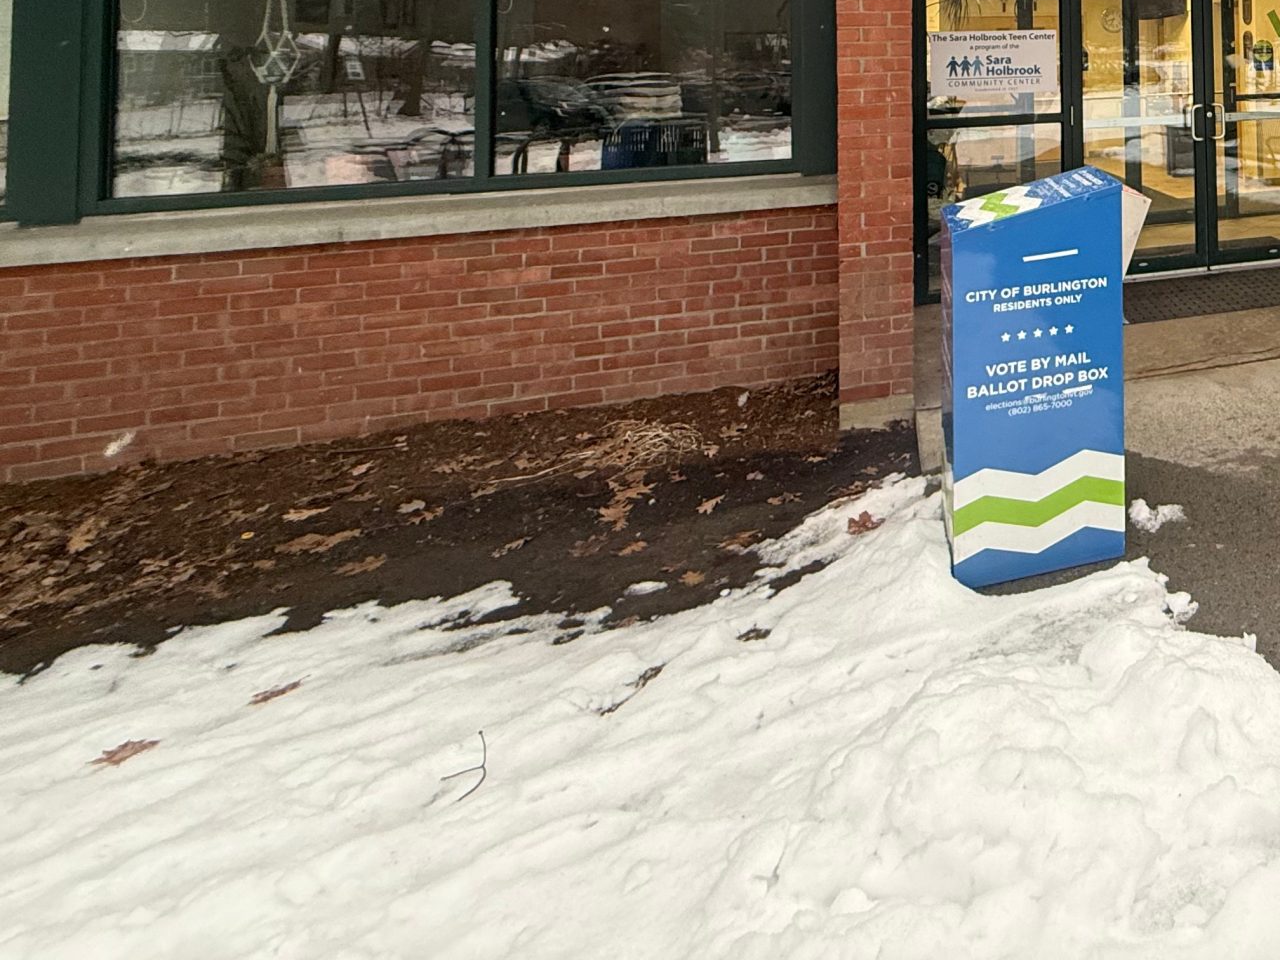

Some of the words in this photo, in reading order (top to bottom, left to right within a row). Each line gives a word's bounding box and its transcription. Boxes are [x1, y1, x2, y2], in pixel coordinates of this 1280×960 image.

[932, 34, 947, 42] The
[949, 34, 967, 42] Sara
[969, 33, 1007, 41] Holbrook
[1008, 33, 1027, 41] Teen
[1029, 32, 1055, 40] Center
[986, 55, 1012, 65] Sara
[986, 65, 1041, 76] Holbrook
[948, 79, 1003, 88] COMMUNITY
[1008, 78, 1040, 86] CENTER
[966, 289, 997, 303] CITY
[1001, 286, 1020, 299] OF
[1023, 277, 1108, 296] BURLINGTON
[993, 298, 1052, 313] RESIDENTS
[1054, 294, 1082, 306] ONLY
[986, 360, 1027, 377] VOTE
[1031, 357, 1051, 370] BY
[1055, 352, 1091, 367] MAIL
[967, 381, 1027, 399] BALLOT
[1032, 373, 1074, 389] DROP
[1078, 367, 1108, 382] BOX
[1008, 405, 1031, 416] (802)
[1033, 399, 1072, 412] 865-7000
